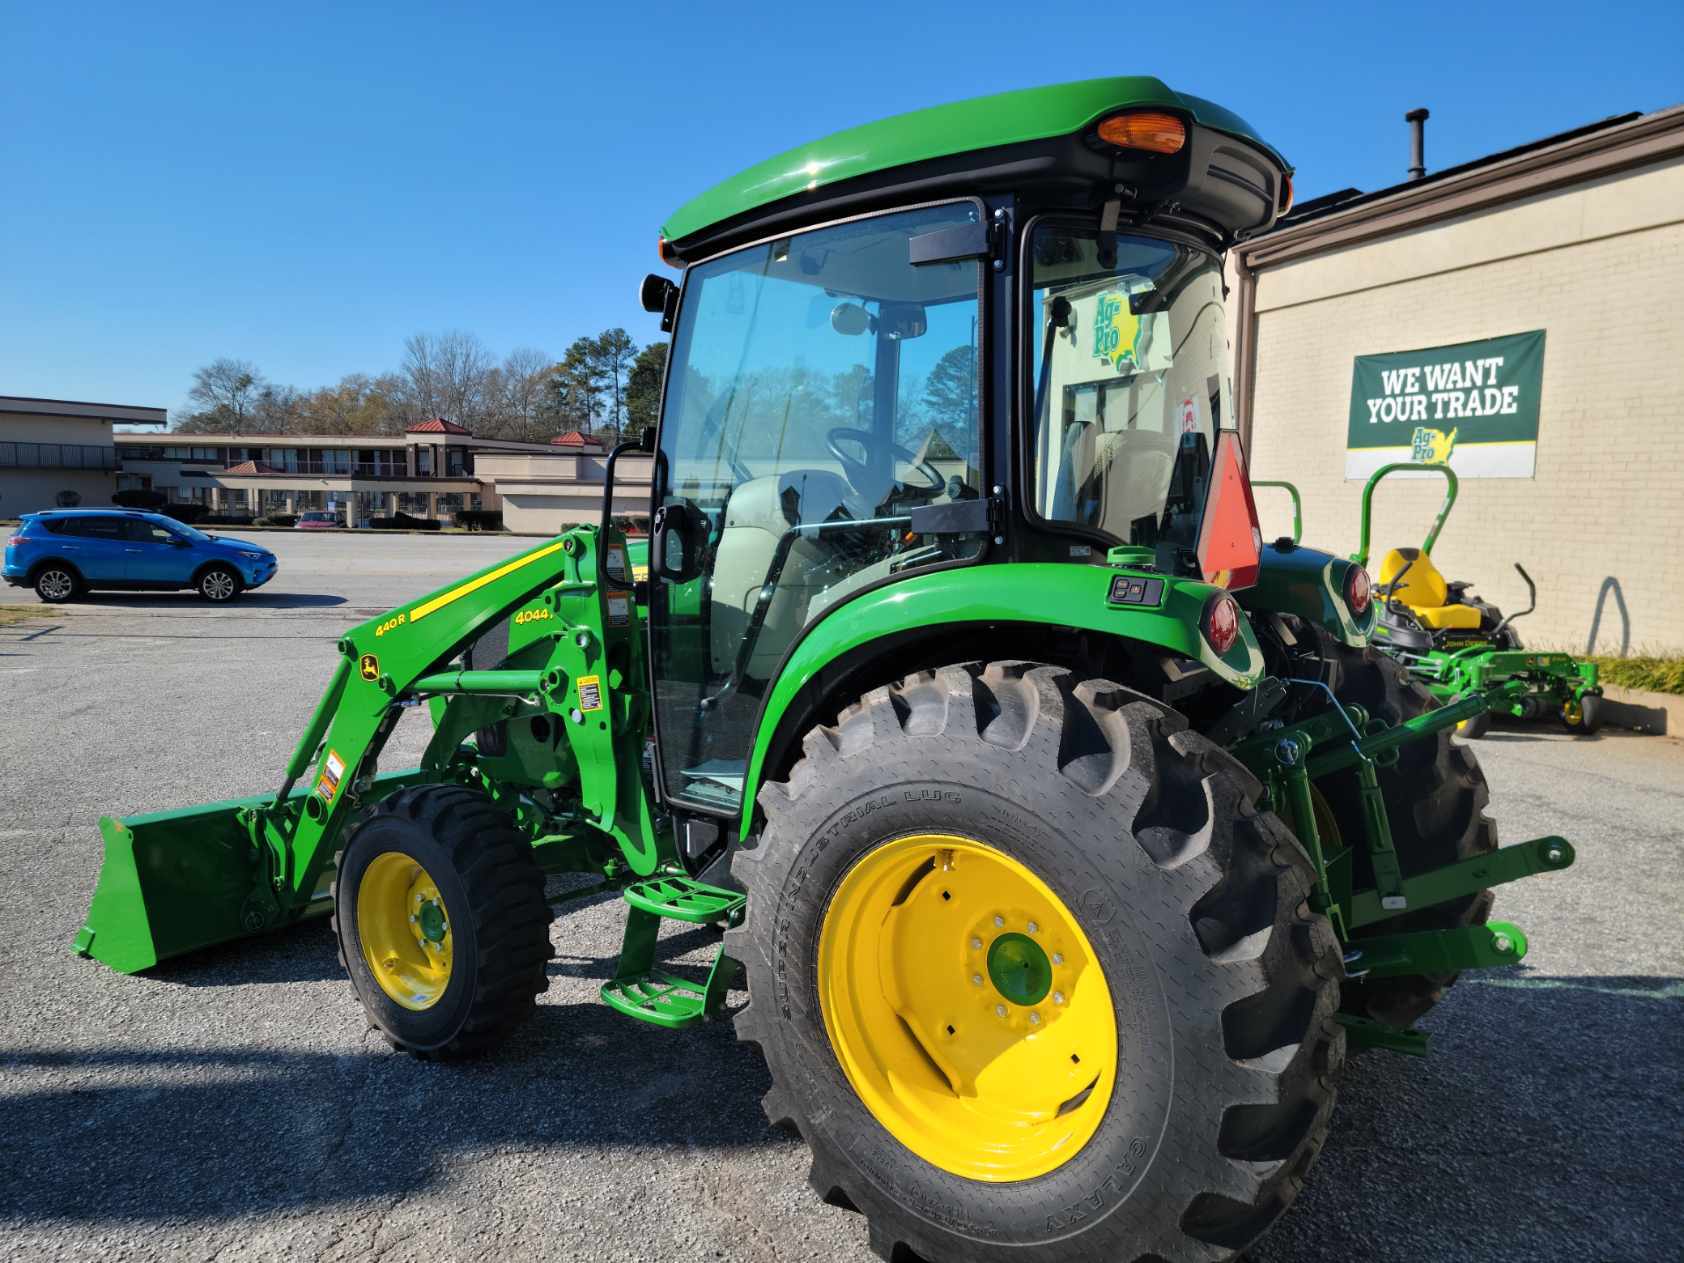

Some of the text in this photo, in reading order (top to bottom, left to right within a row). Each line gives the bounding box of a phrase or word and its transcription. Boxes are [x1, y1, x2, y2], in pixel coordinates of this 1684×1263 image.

[1093, 325, 1120, 358] Pro
[1381, 357, 1504, 395] WE WANT
[1367, 385, 1519, 424] YOUR TRADE
[903, 789, 963, 804] LUG
[1047, 1138, 1147, 1233] GALAXY
